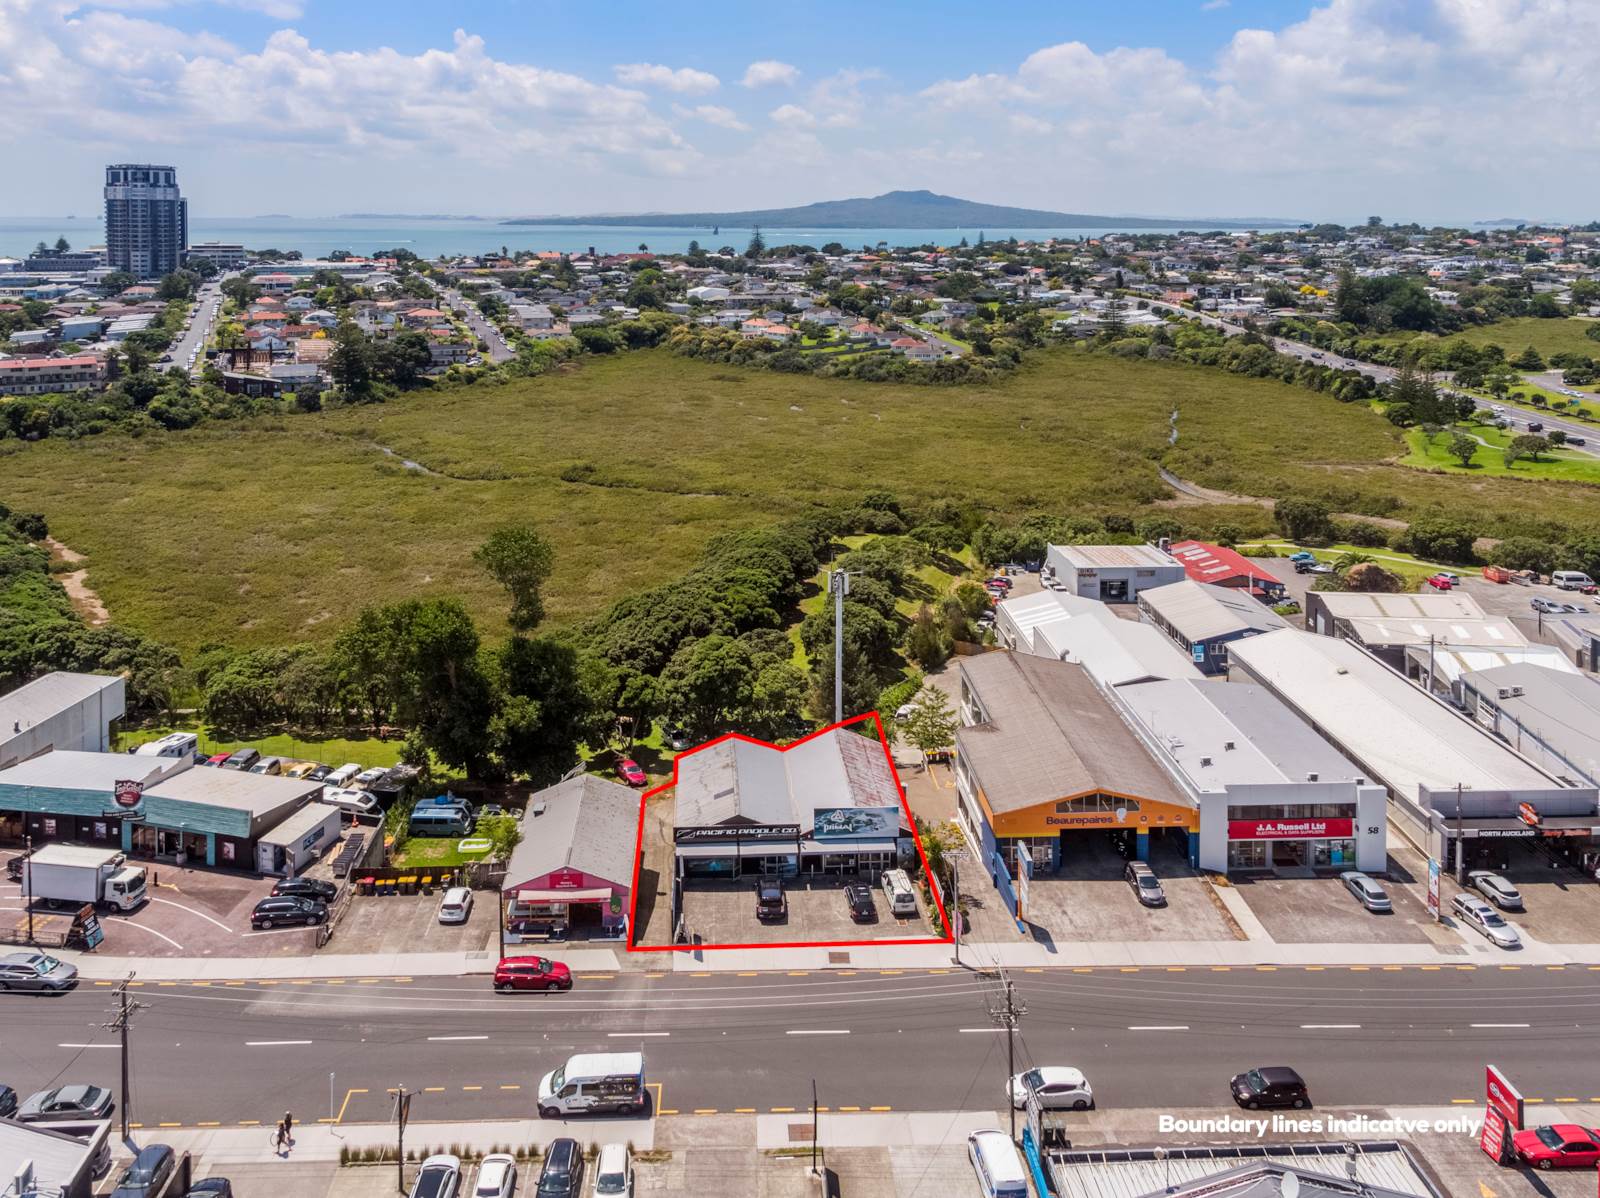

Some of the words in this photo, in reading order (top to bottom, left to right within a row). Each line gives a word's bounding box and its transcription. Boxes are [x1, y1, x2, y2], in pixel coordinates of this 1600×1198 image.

[1046, 816, 1113, 826] Beaurepaires
[1311, 822, 1326, 830] Ltd
[1367, 826, 1379, 834] 58
